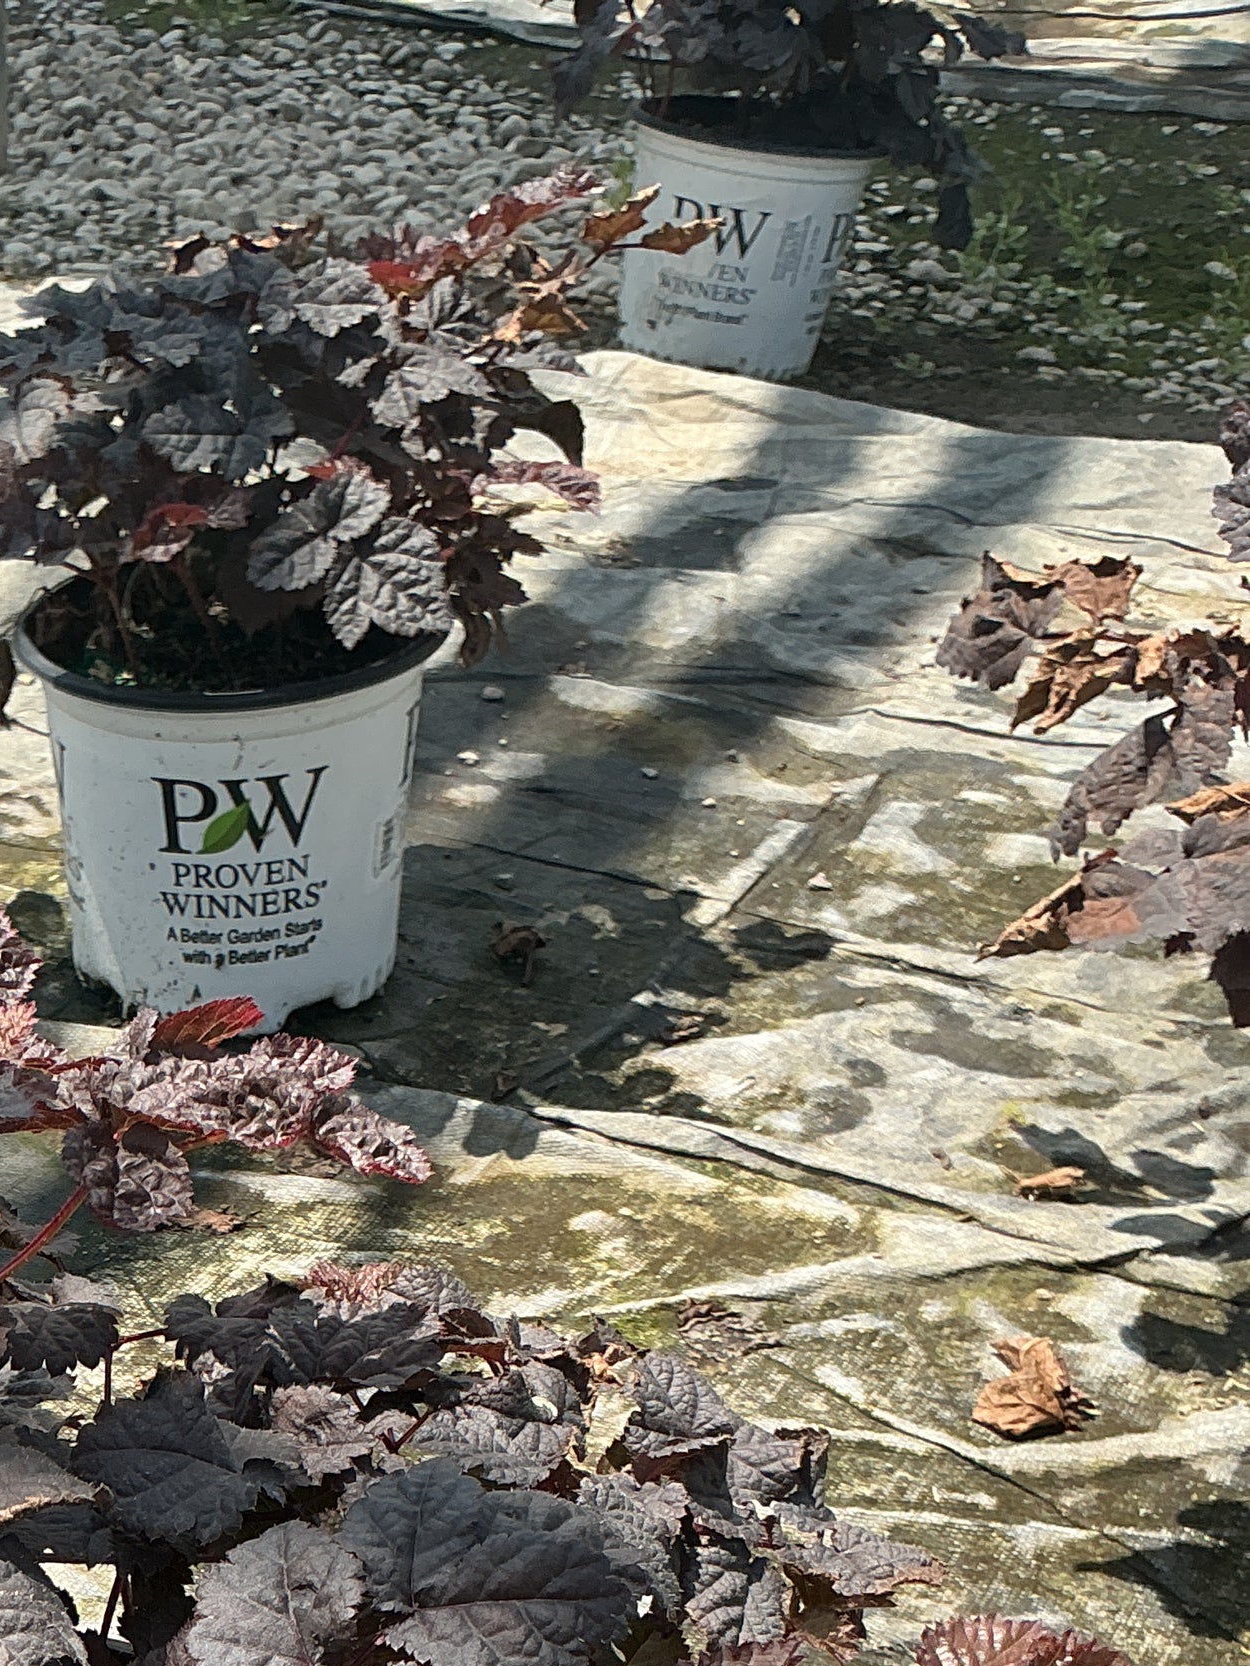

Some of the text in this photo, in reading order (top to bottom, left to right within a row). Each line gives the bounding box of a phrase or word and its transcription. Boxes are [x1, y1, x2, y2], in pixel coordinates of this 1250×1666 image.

[150, 765, 330, 854] PW
[171, 854, 310, 889] PROVEN
[159, 882, 322, 919] WINNERS
[166, 917, 323, 945] A Better Garden Starts
[182, 949, 211, 965] with
[228, 949, 272, 966] Better
